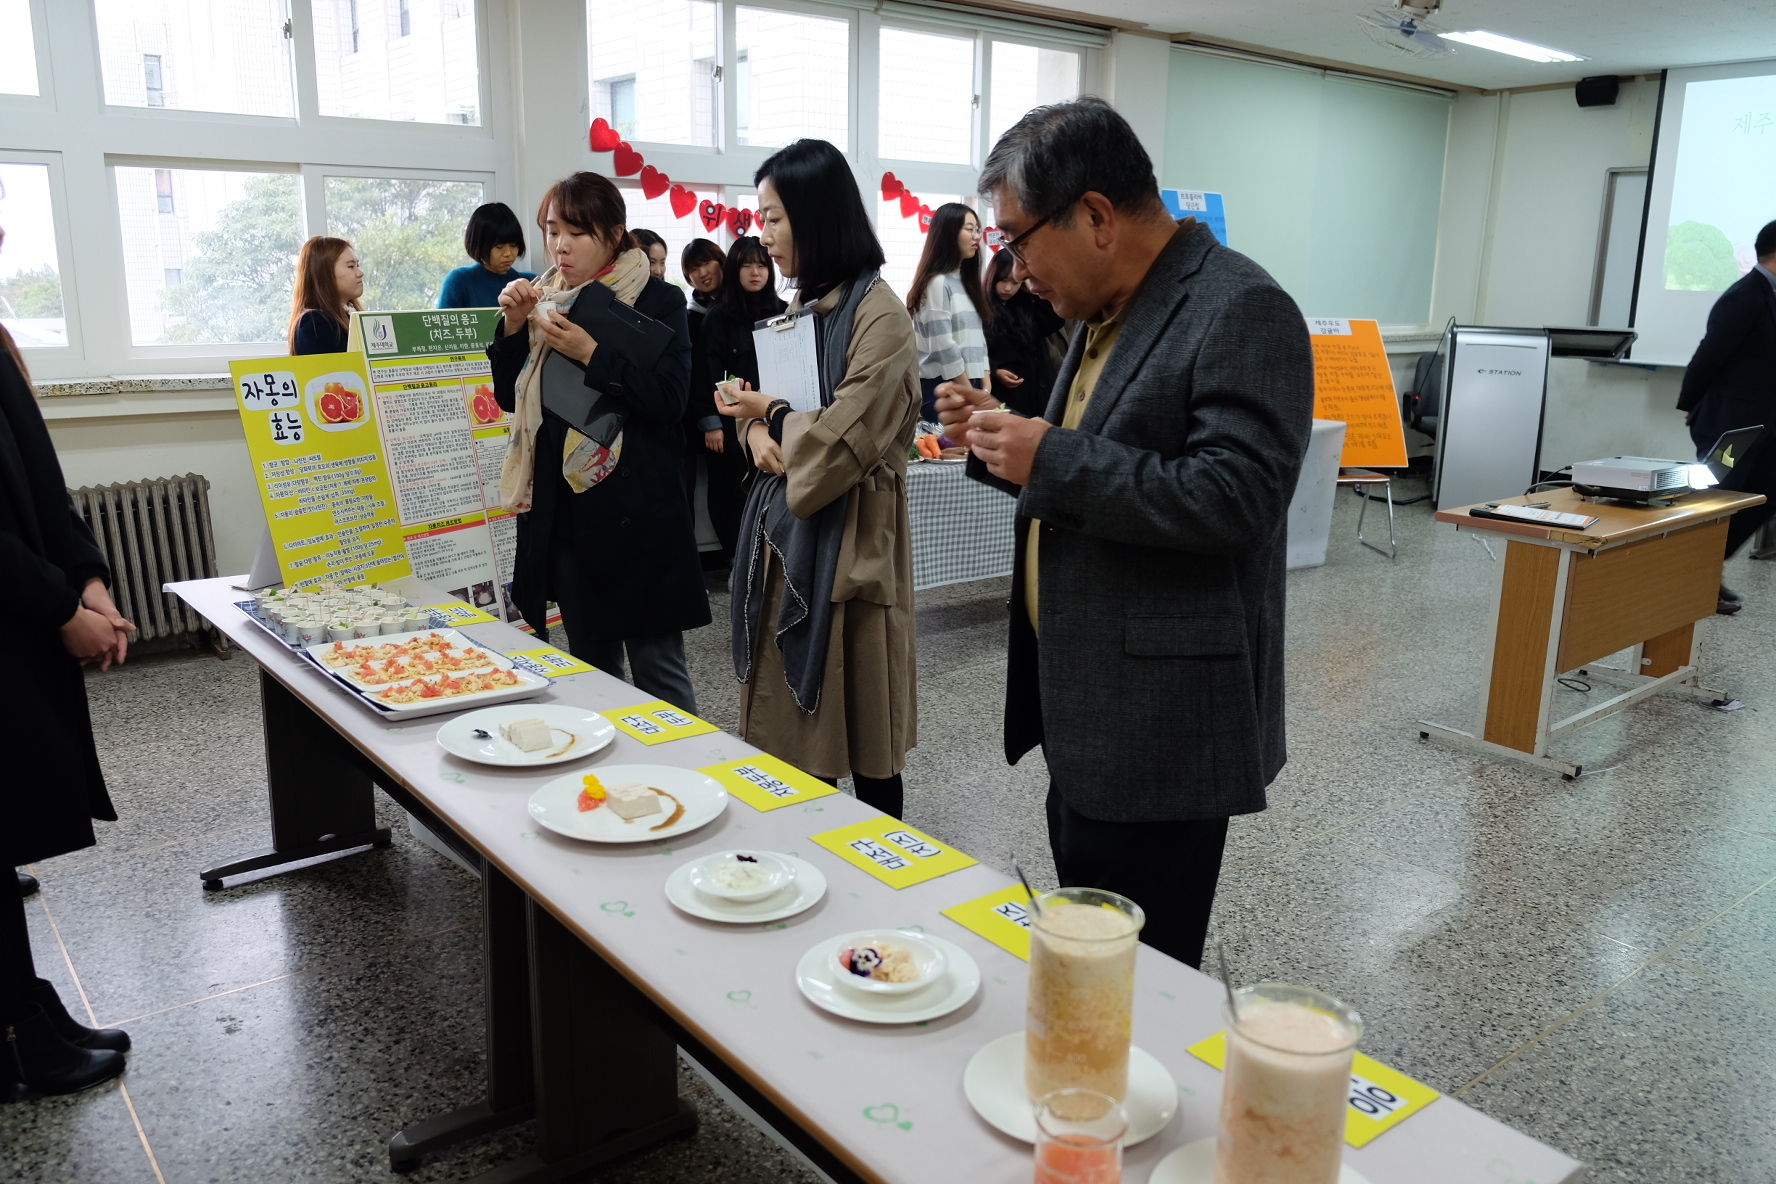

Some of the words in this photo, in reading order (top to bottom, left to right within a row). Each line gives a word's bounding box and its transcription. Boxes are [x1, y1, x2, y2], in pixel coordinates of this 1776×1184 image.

[1732, 111, 1774, 135] 제주
[422, 314, 459, 327] 단백질의
[460, 314, 478, 325] 응고
[429, 328, 454, 341] (치즈,
[456, 328, 478, 340] 두부)
[242, 374, 298, 406] 자몽의
[271, 412, 302, 440] 효능
[621, 714, 660, 735] 대조구
[650, 710, 694, 727] (두부)
[732, 766, 794, 798] 자몽두부
[850, 840, 906, 870] 대조구
[884, 830, 942, 858] (치즈)
